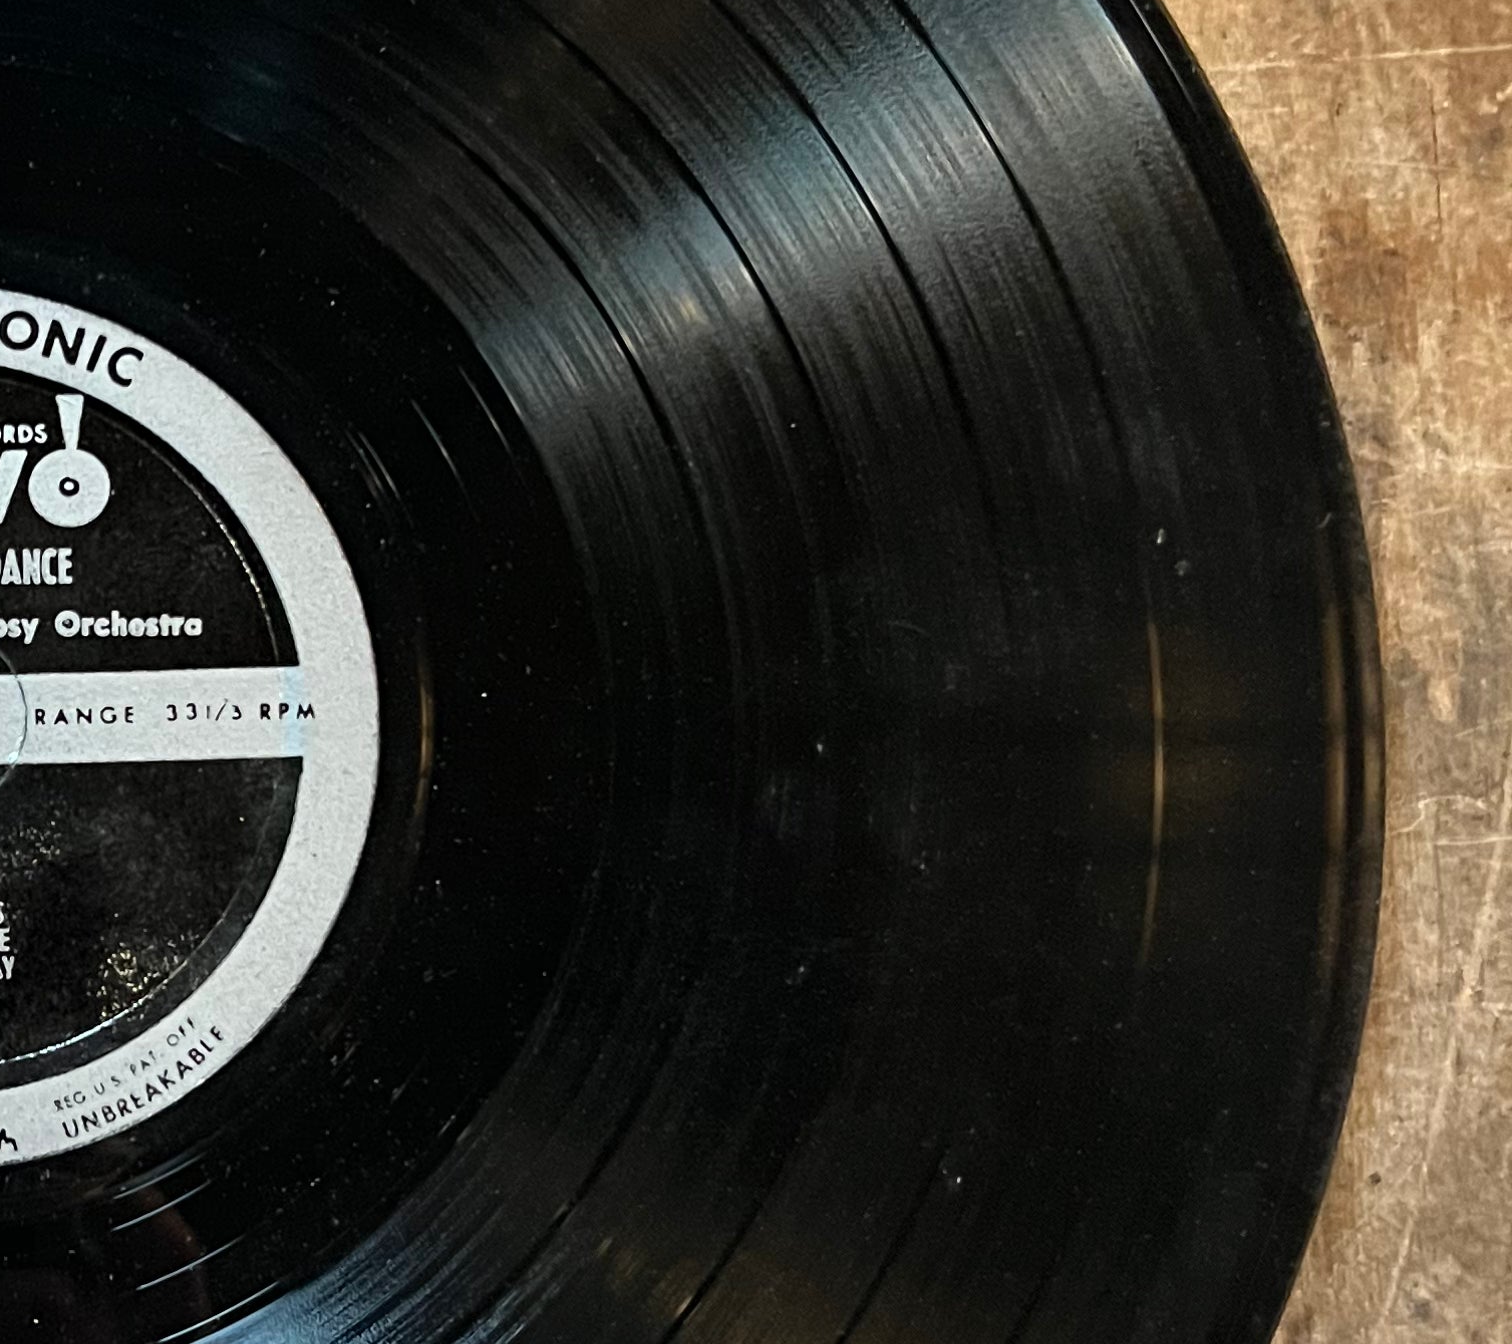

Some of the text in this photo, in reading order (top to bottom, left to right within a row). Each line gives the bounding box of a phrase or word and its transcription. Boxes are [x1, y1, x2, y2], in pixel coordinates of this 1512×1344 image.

[34, 706, 135, 725] RANGE
[260, 702, 316, 720] RPM
[62, 1025, 224, 1139] UNBREAKABLE
